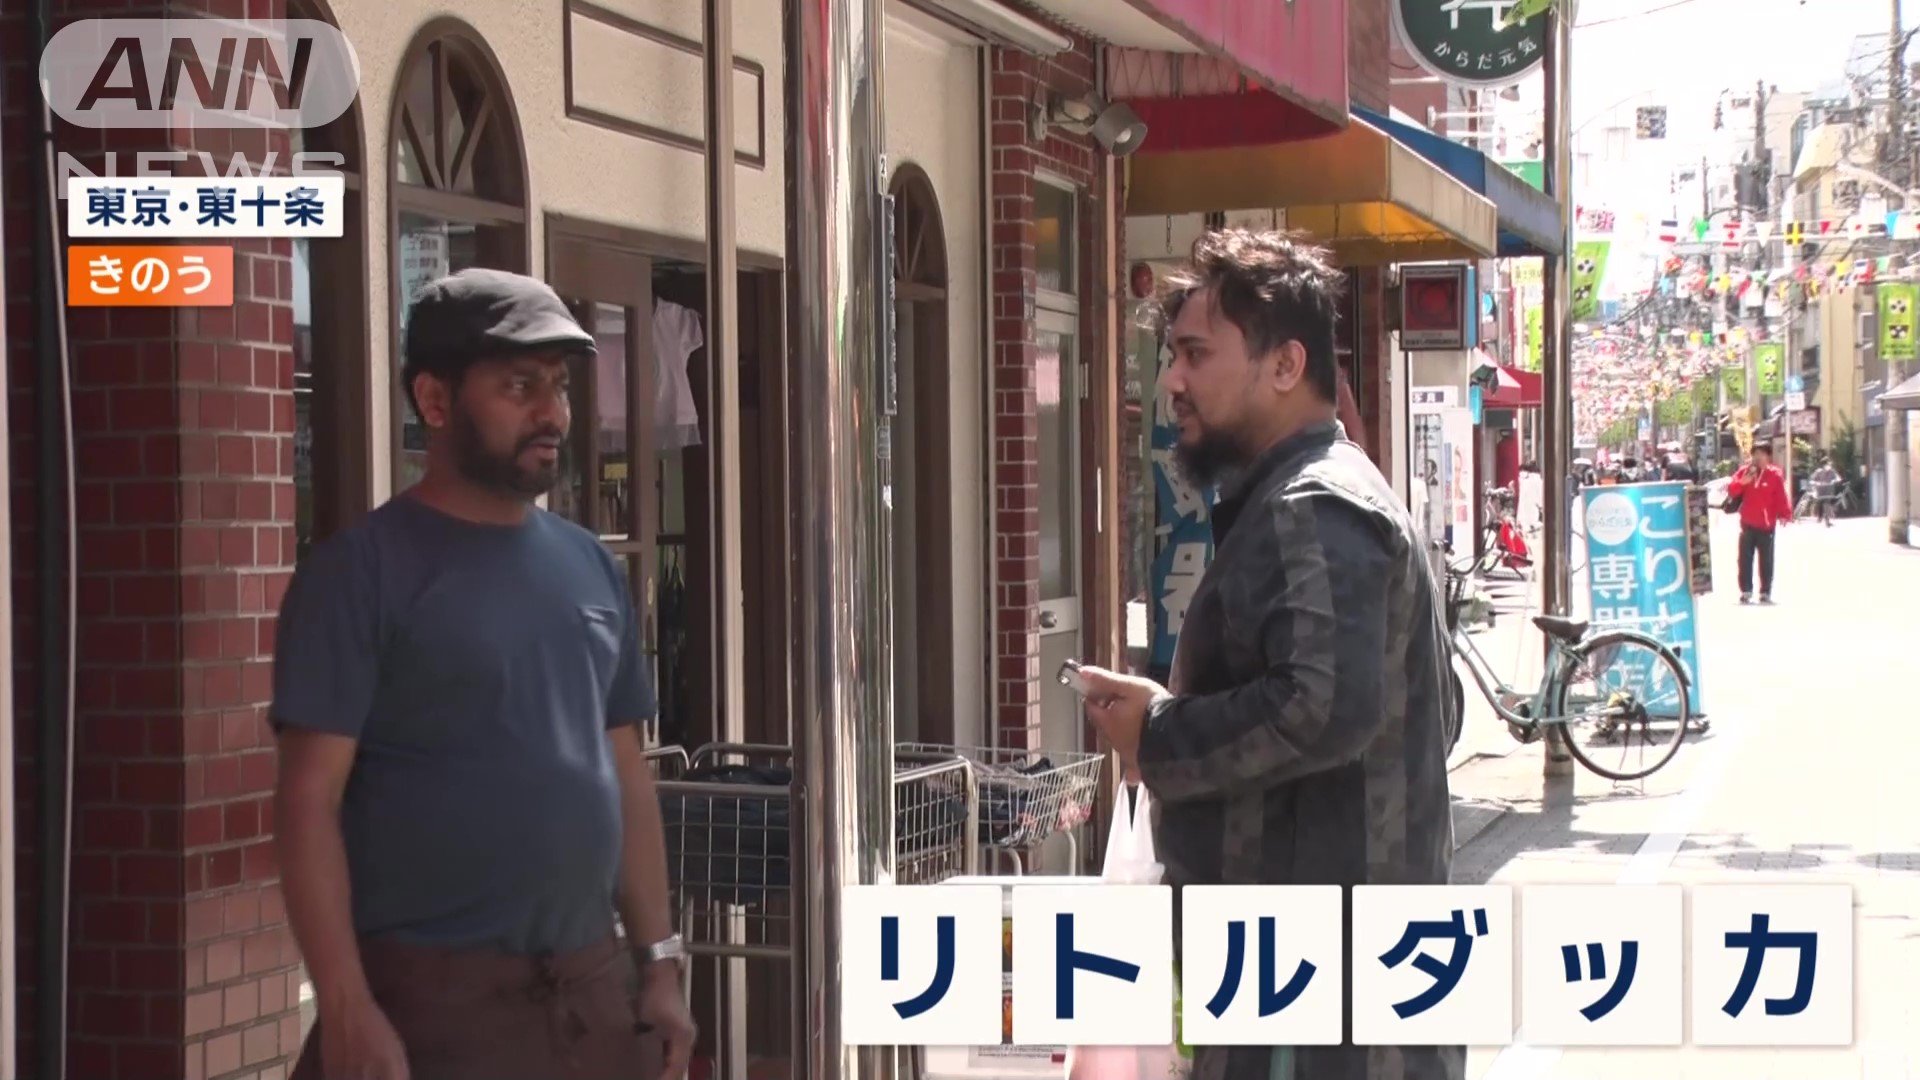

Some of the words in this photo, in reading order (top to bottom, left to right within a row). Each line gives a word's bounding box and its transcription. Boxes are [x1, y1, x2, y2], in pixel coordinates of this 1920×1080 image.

[1434, 37, 1537, 69] からだ元気
